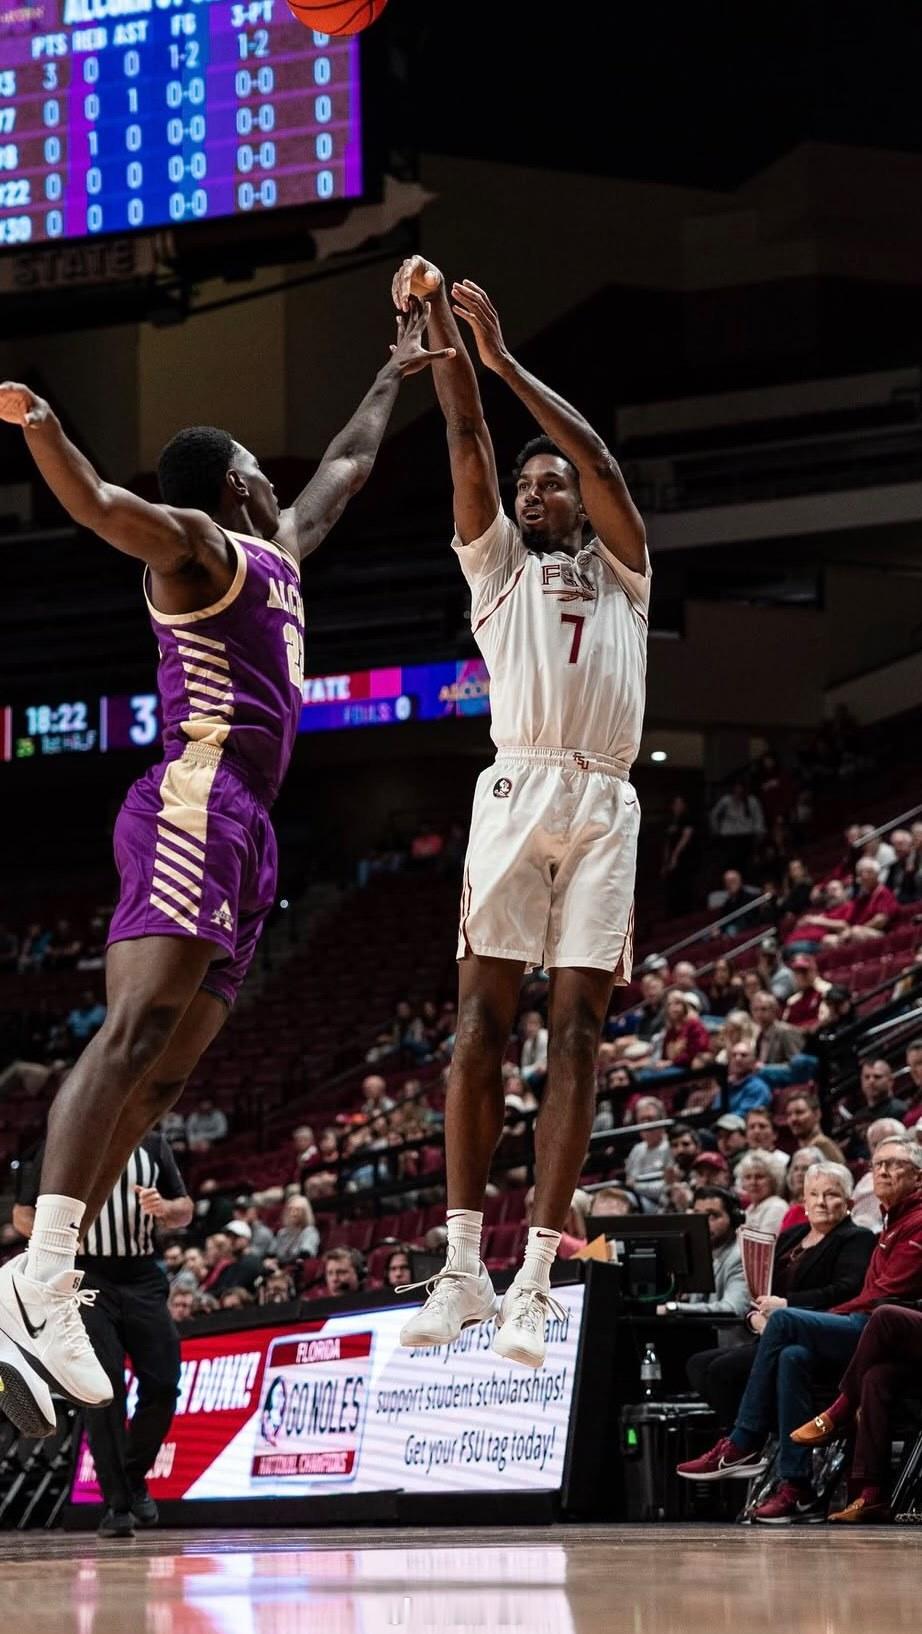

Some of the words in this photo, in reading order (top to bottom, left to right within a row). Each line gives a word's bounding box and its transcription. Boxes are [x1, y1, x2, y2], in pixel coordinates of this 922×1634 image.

[32, 33, 67, 59] PTS
[72, 27, 107, 51] REB
[113, 20, 148, 46] AST
[171, 13, 196, 37] FG
[231, 0, 274, 27] 3-PT
[43, 62, 58, 90] 3
[83, 57, 99, 84] 0
[124, 50, 140, 78] 0
[169, 41, 200, 69] 1-2
[238, 29, 269, 60] 1-2
[43, 100, 60, 128] 0
[84, 94, 100, 121] 0
[128, 88, 139, 114] 1
[166, 78, 205, 108] 0-0
[235, 66, 274, 98] 0-0
[314, 57, 331, 86] 0
[44, 136, 61, 164] 0
[88, 131, 99, 156] 1
[126, 124, 142, 152] 0
[167, 115, 206, 146] 0-0
[236, 104, 275, 137] 0-0
[315, 95, 332, 124] 0
[45, 172, 62, 200] 0
[86, 167, 102, 195] 0
[127, 161, 143, 189] 0
[168, 152, 207, 182] 0-0
[237, 141, 276, 174] 0-0
[316, 133, 333, 161] 0
[46, 210, 63, 238] 0
[87, 204, 103, 232] 0
[128, 198, 144, 226] 0
[169, 189, 207, 221] 0-0
[238, 179, 277, 211] 0-0
[316, 170, 334, 199] 0
[14, 238, 135, 285] STATE
[560, 613, 586, 664] 7
[26, 702, 88, 736] 18:22
[129, 695, 157, 746] 3
[395, 695, 412, 721] 0
[573, 752, 590, 770] FSU
[296, 1338, 341, 1364] FLORIDA
[188, 1351, 261, 1414] DUNK!
[286, 1383, 309, 1436] GO
[307, 1376, 363, 1435] NOLES
[376, 1383, 424, 1422] support
[425, 1375, 474, 1411] student
[476, 1367, 567, 1411] scholarships!
[404, 1434, 426, 1465] Get
[426, 1439, 458, 1474] your
[459, 1430, 485, 1463] FSU
[487, 1433, 507, 1471] tag
[511, 1424, 556, 1470] today!
